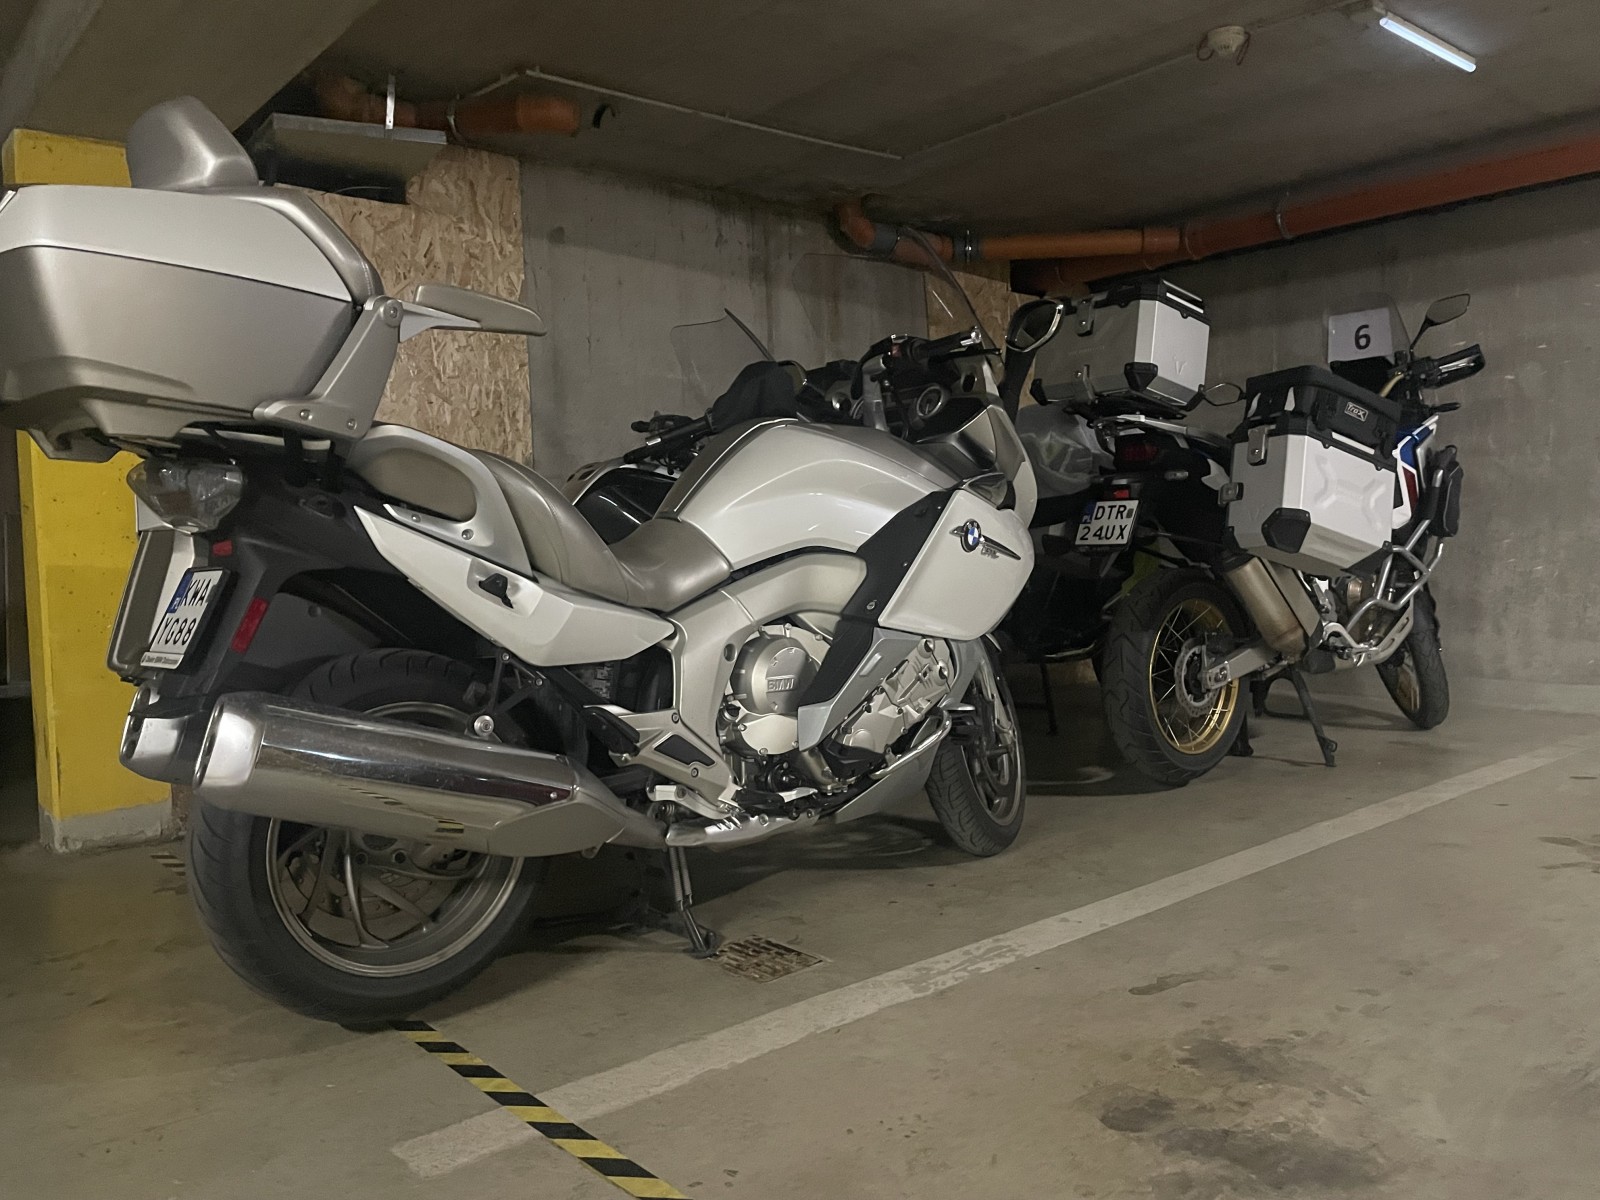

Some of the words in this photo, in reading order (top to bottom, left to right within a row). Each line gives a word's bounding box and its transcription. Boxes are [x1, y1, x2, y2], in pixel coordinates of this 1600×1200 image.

[1354, 324, 1371, 350] 6
[1094, 505, 1127, 520] DTR
[1080, 524, 1128, 540] 24UX
[181, 579, 211, 606] KWA
[158, 617, 197, 646] YG88
[768, 678, 795, 691] BMW
